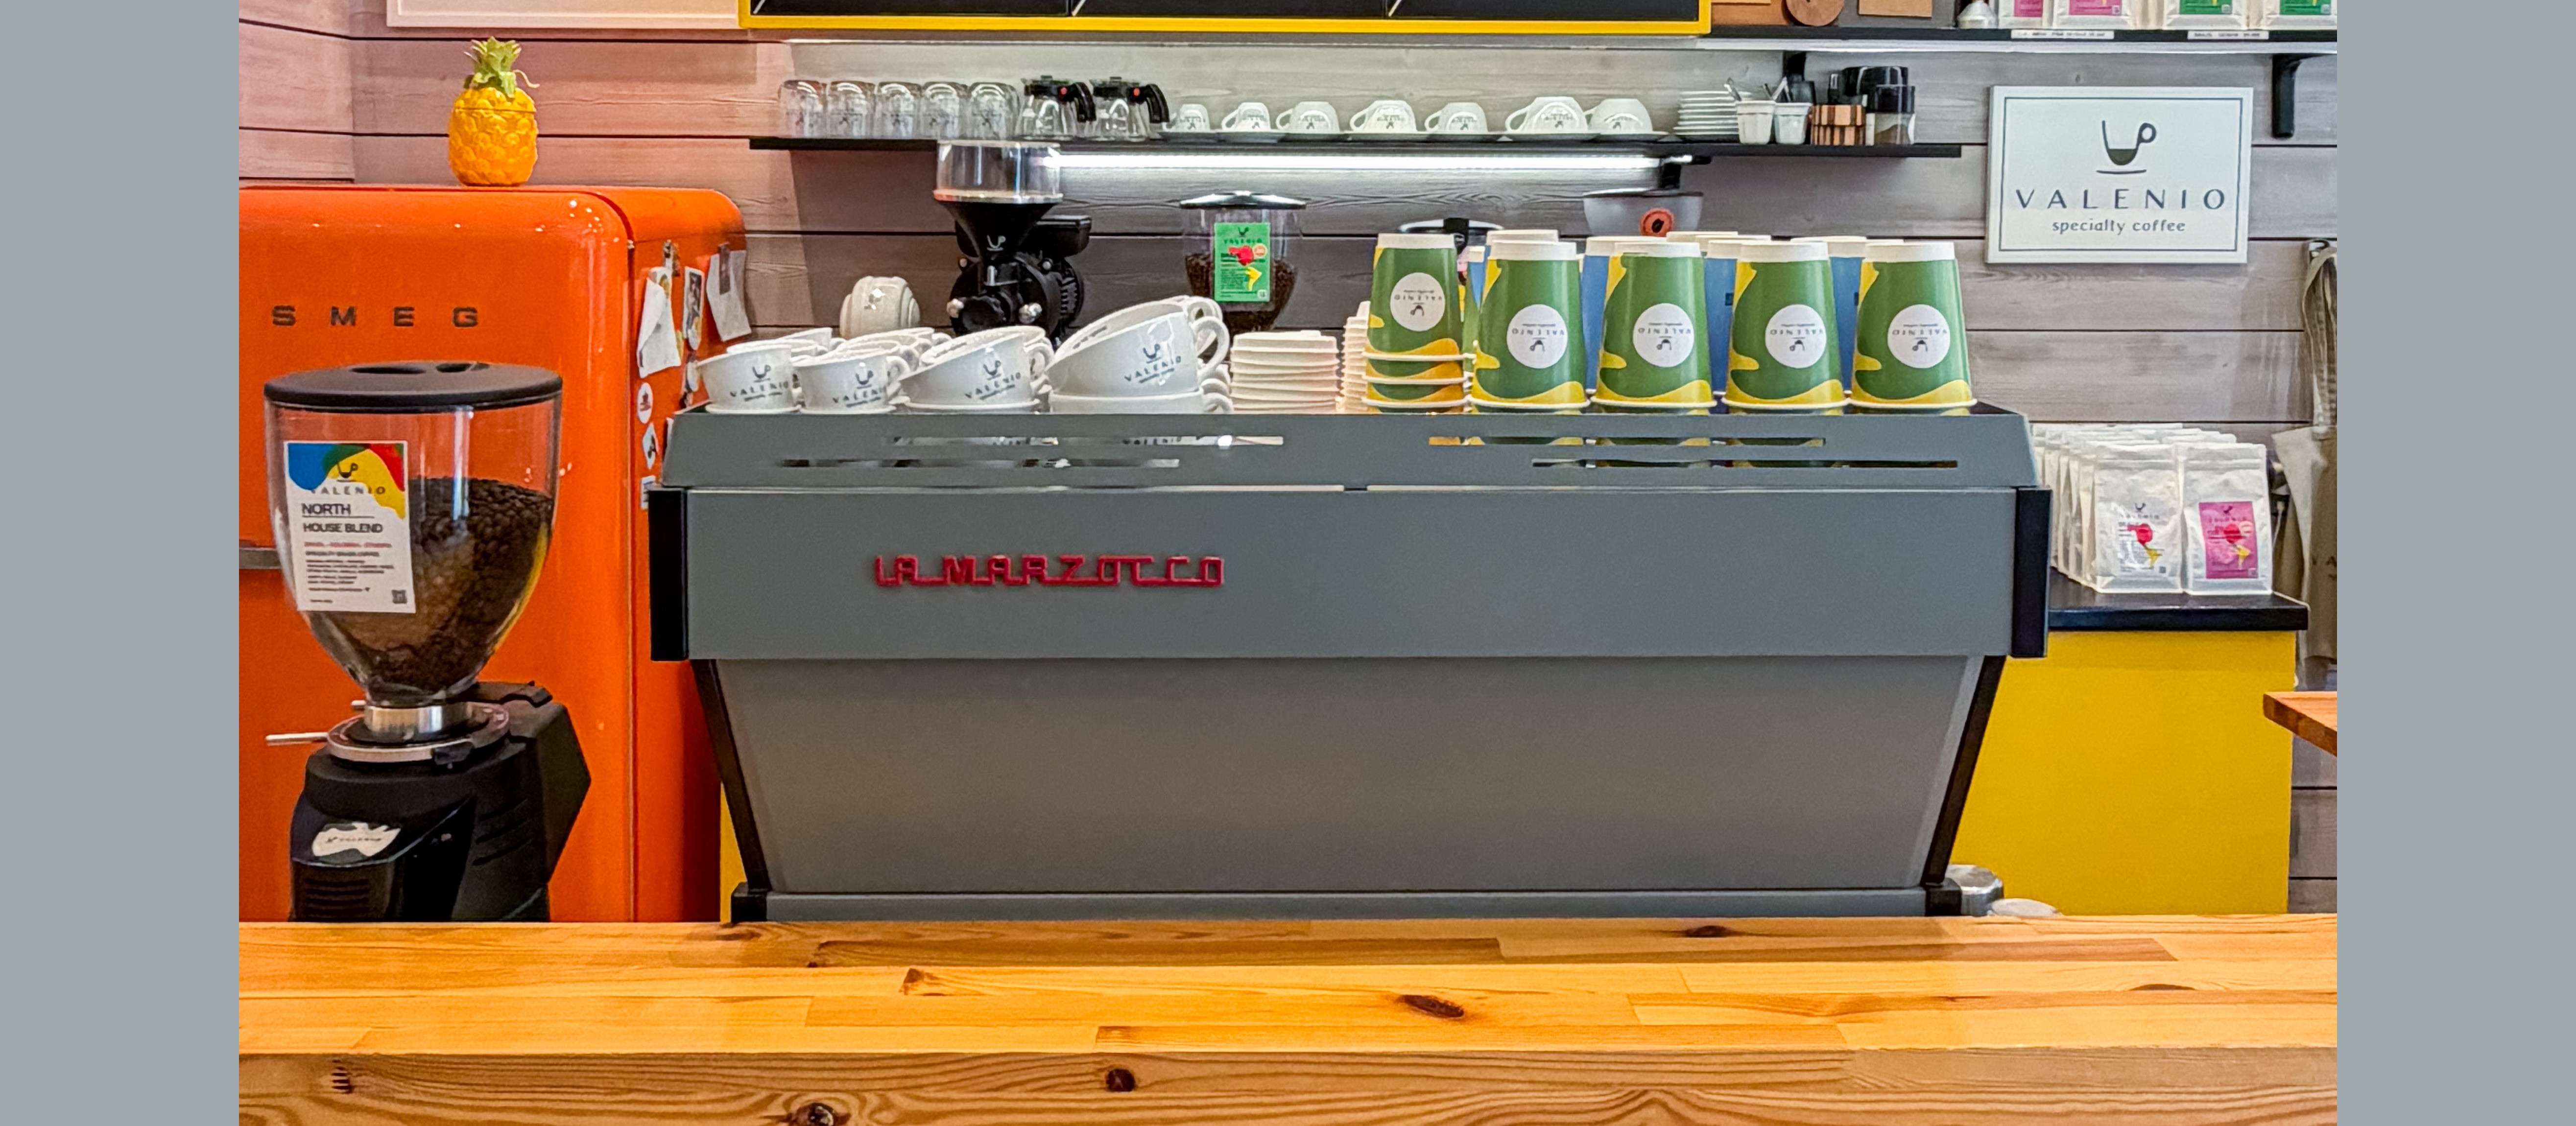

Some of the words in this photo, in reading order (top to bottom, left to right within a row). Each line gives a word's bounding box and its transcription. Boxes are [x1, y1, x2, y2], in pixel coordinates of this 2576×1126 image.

[2015, 188, 2225, 210] VALENIO
[2052, 218, 2125, 235] specialty
[2132, 219, 2186, 232] coffee
[271, 305, 479, 328] SMEG
[301, 503, 352, 515] NORTH
[303, 522, 342, 533] HOUSE
[344, 523, 383, 533] BLEND
[875, 555, 919, 586] LA
